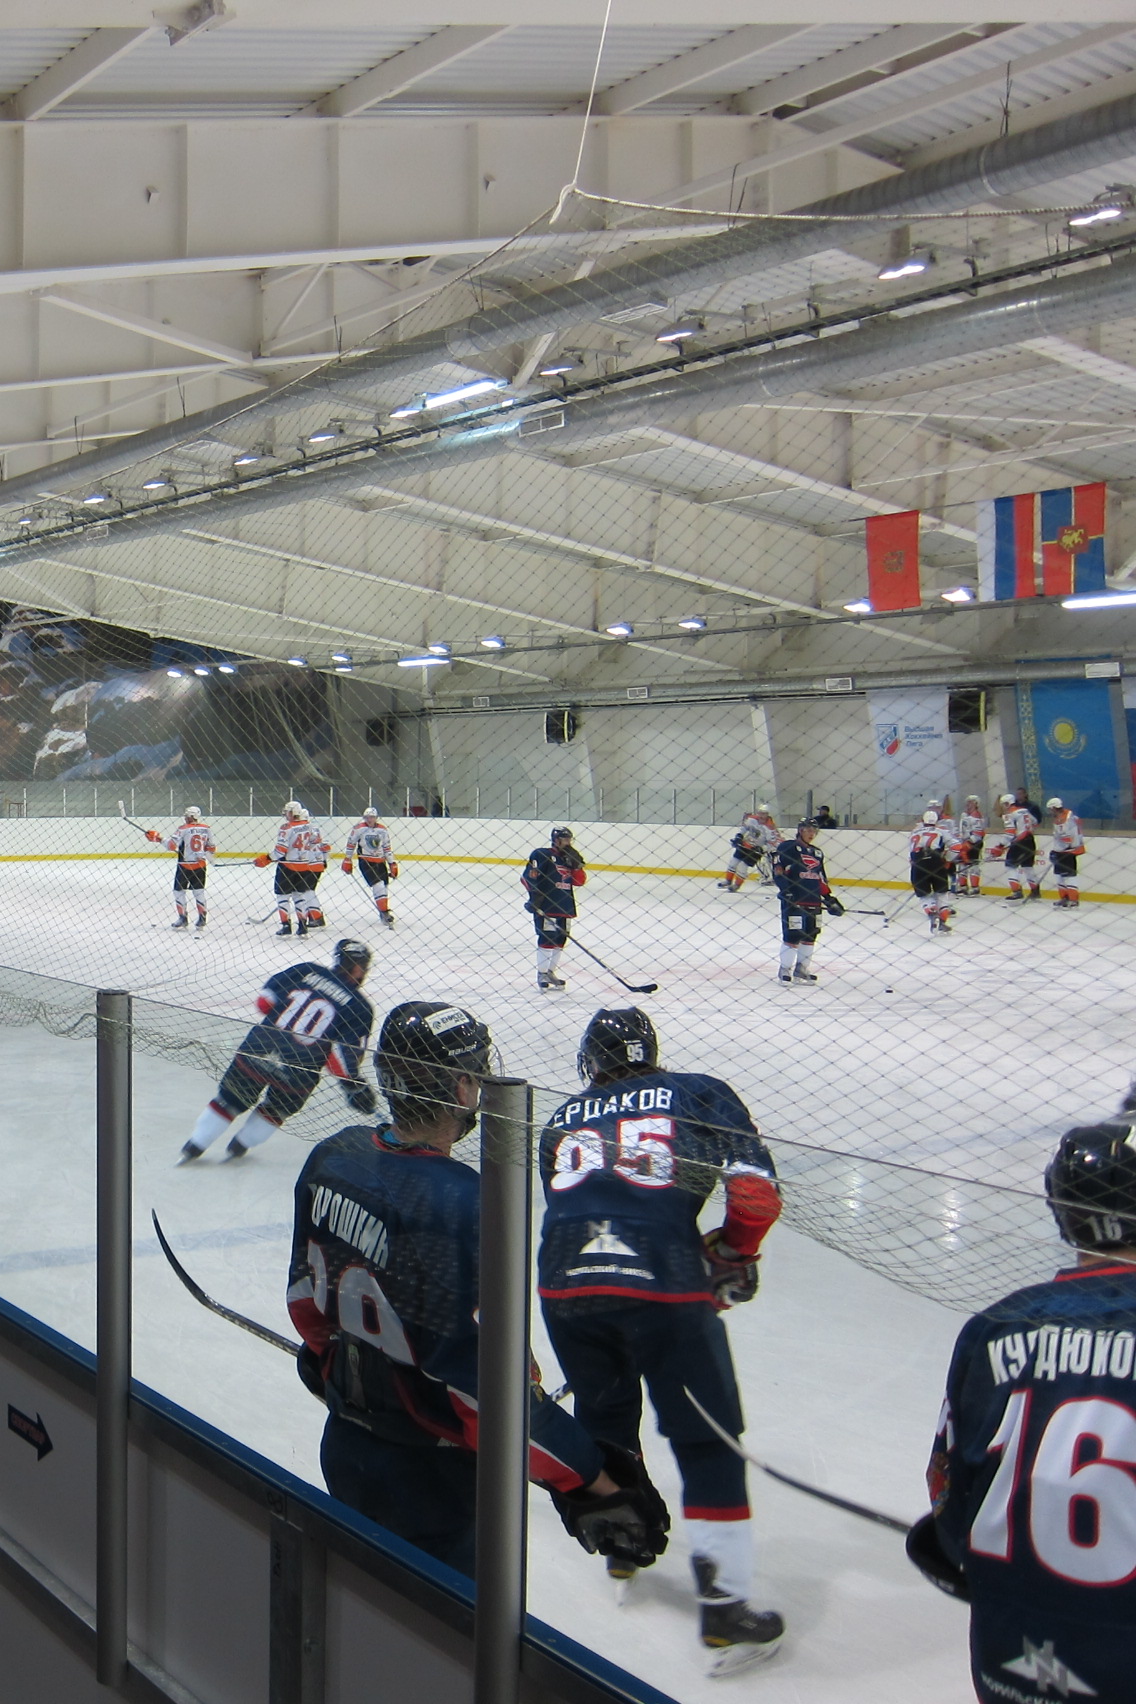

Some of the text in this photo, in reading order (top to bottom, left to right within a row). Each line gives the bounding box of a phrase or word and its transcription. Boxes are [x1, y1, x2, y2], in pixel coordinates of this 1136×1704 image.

[275, 988, 336, 1046] 10
[626, 1043, 644, 1062] 95
[550, 1114, 676, 1192] 95
[1087, 1215, 1123, 1241] 16
[987, 1323, 1136, 1386] КУДЮКО
[969, 1387, 1136, 1588] 16
